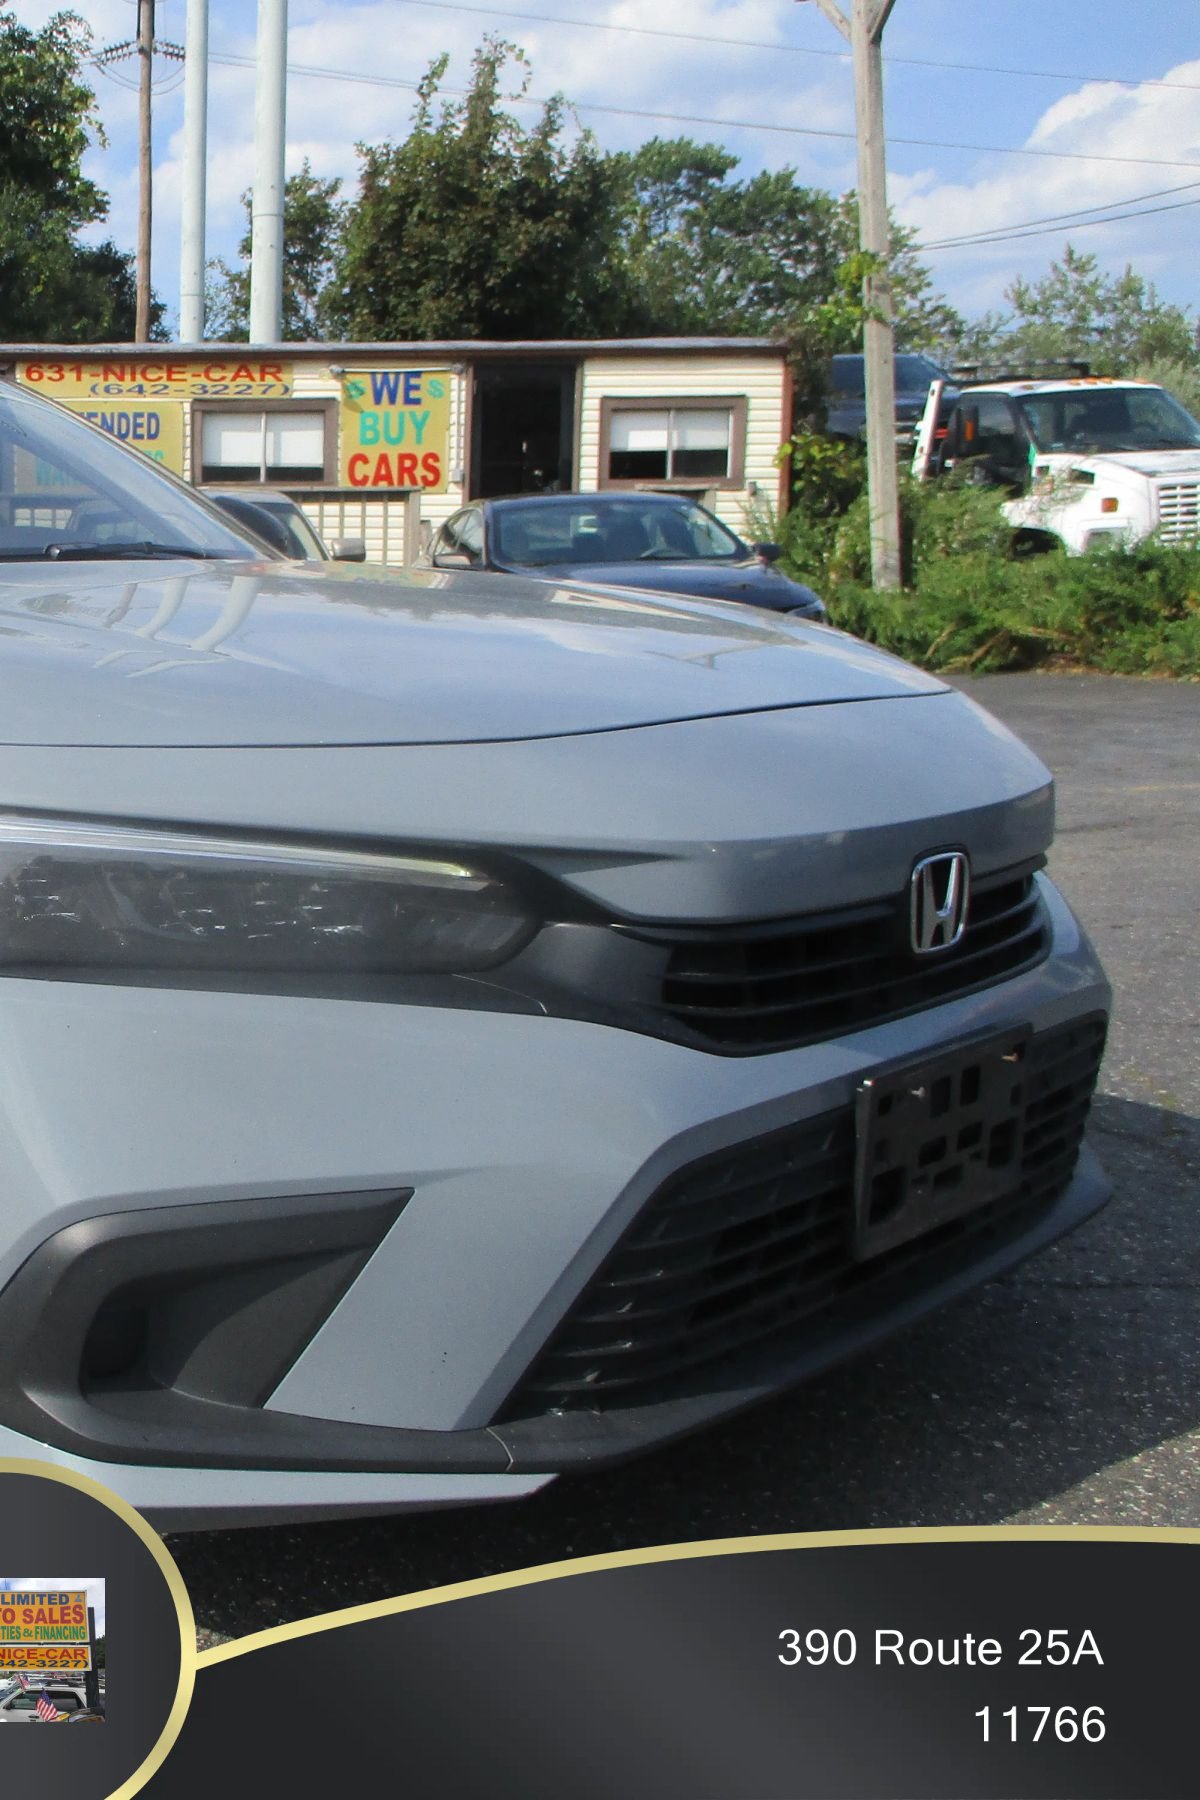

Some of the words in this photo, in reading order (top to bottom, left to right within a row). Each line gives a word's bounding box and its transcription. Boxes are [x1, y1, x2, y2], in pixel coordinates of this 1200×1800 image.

[24, 363, 284, 382] 631-NICE-CAR
[89, 383, 290, 396] (642-3227)
[370, 371, 423, 405] WE
[359, 410, 431, 446] BUY
[347, 452, 441, 487] CARS
